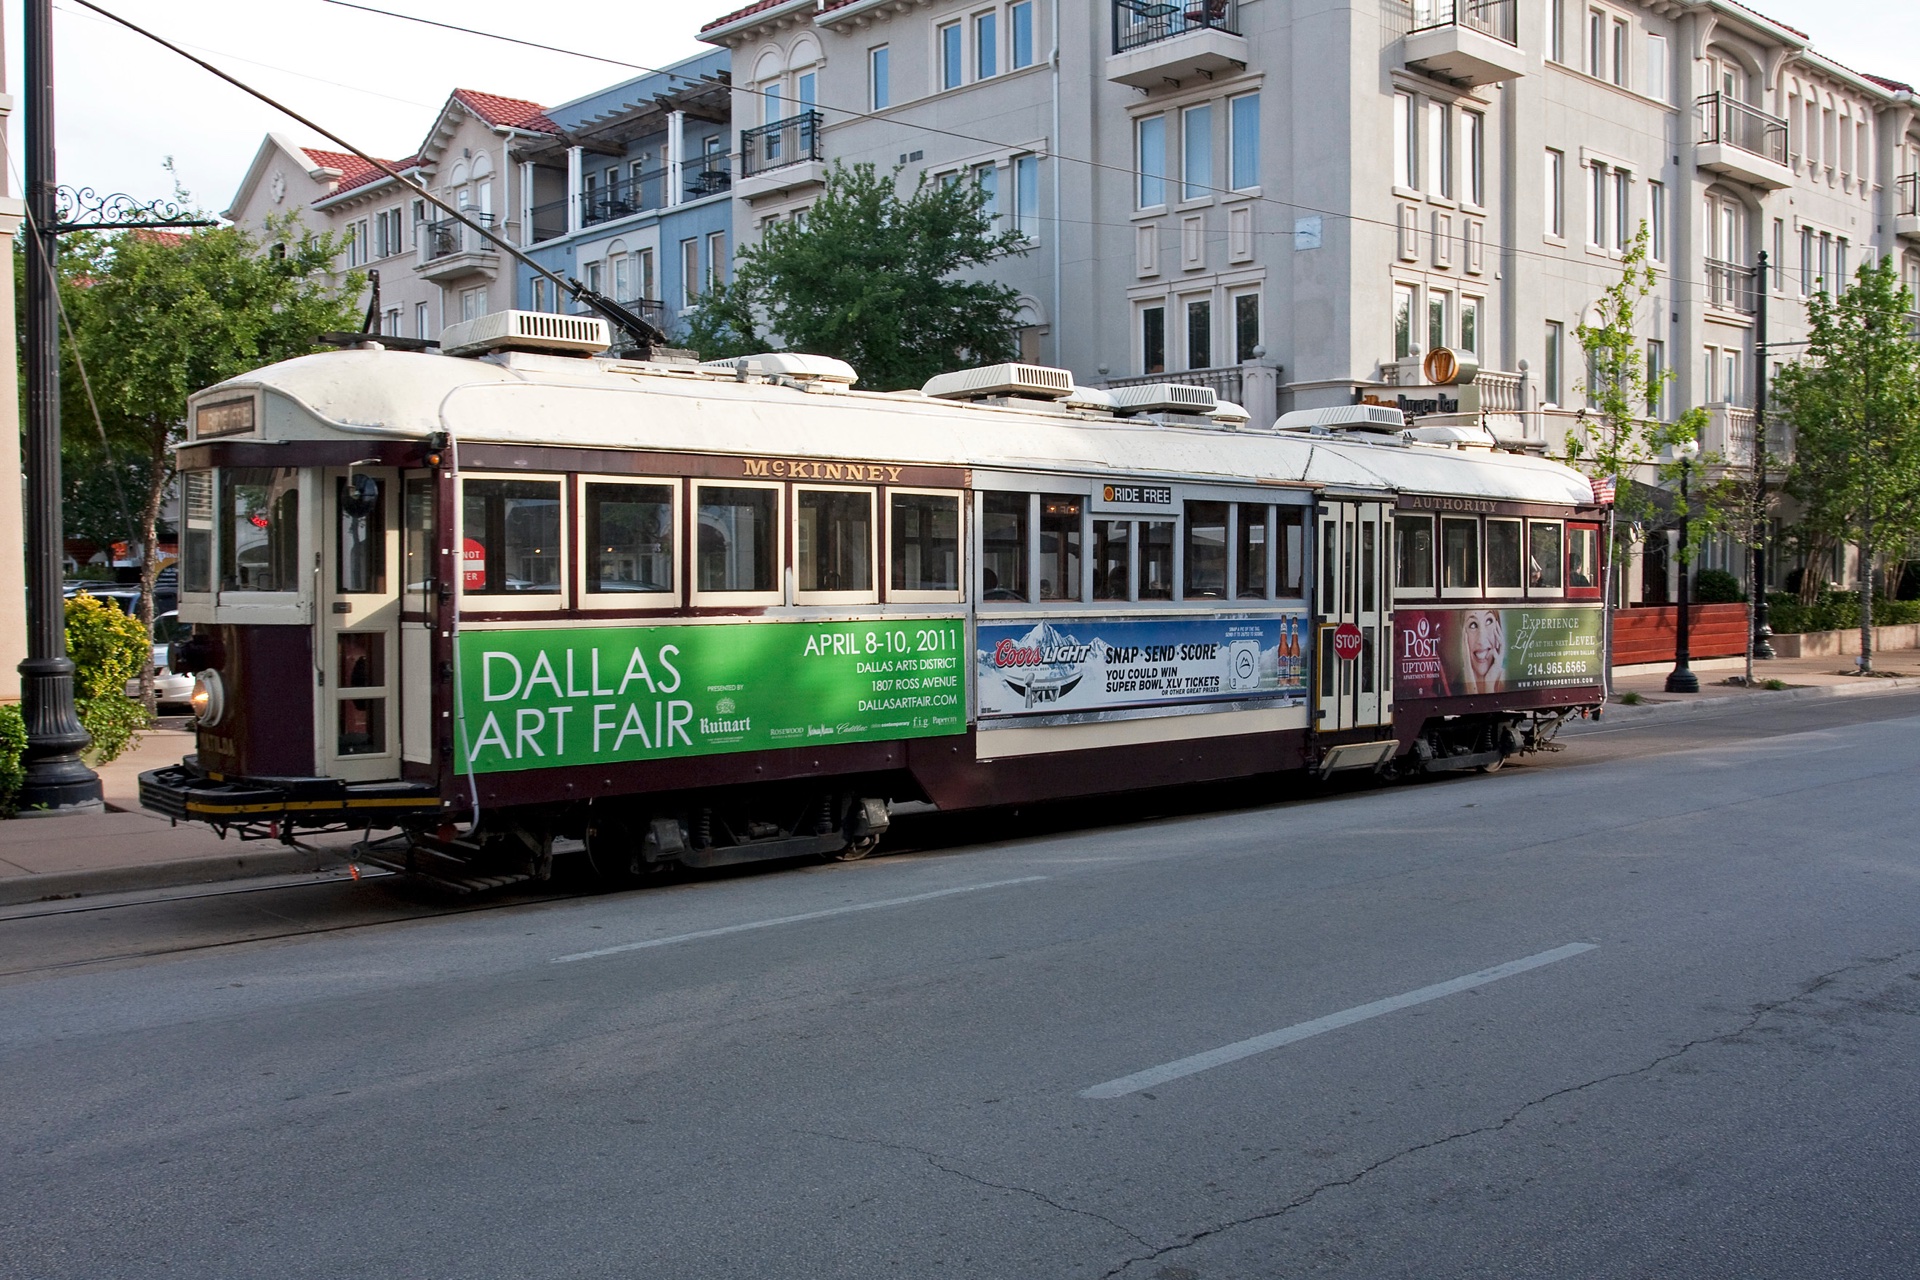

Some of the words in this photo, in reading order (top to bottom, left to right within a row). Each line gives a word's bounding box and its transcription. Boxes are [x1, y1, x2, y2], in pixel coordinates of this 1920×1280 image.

[1438, 393, 1458, 412] bar
[1114, 488, 1139, 502] RIDE
[1143, 489, 1170, 503] FREE
[1412, 497, 1497, 512] AUTHORITY
[803, 633, 860, 656] APRIL
[865, 630, 911, 654] 8-10,
[916, 629, 956, 651] 2011
[1336, 634, 1360, 648] STOP
[1511, 624, 1538, 665] Life
[1569, 632, 1595, 646] LEVEL
[995, 638, 1041, 668] Coors
[1042, 645, 1091, 664] LIGHT
[1106, 646, 1139, 664] SNAP
[1144, 645, 1175, 662] SEND
[1180, 644, 1218, 660] SCORE
[483, 644, 681, 702] DALLAS
[857, 661, 893, 674] DALLAS
[895, 659, 917, 671] ARTS
[920, 658, 957, 670] DISTRICT
[1106, 669, 1125, 681] YOU
[1128, 668, 1158, 679] COULD
[1161, 667, 1178, 677] WIN
[1402, 661, 1440, 674] UPTOWN
[1527, 661, 1586, 675] 214.965.6565
[872, 680, 893, 692] 1807
[896, 678, 919, 690] ROSS
[922, 676, 957, 688] AVENUE
[1106, 680, 1136, 693] SUPER
[1139, 679, 1163, 691] BOWL
[1166, 678, 1183, 689] XLV
[1185, 676, 1220, 688] TICKETS
[858, 694, 958, 712] DALLASARTFAIR.COM
[1032, 689, 1058, 703] XLV
[470, 706, 573, 762] ART
[593, 700, 693, 752] FAIR
[699, 717, 751, 734] Ruinart
[770, 727, 804, 736] ROSEWOOD
[836, 722, 868, 734] Cadillac
